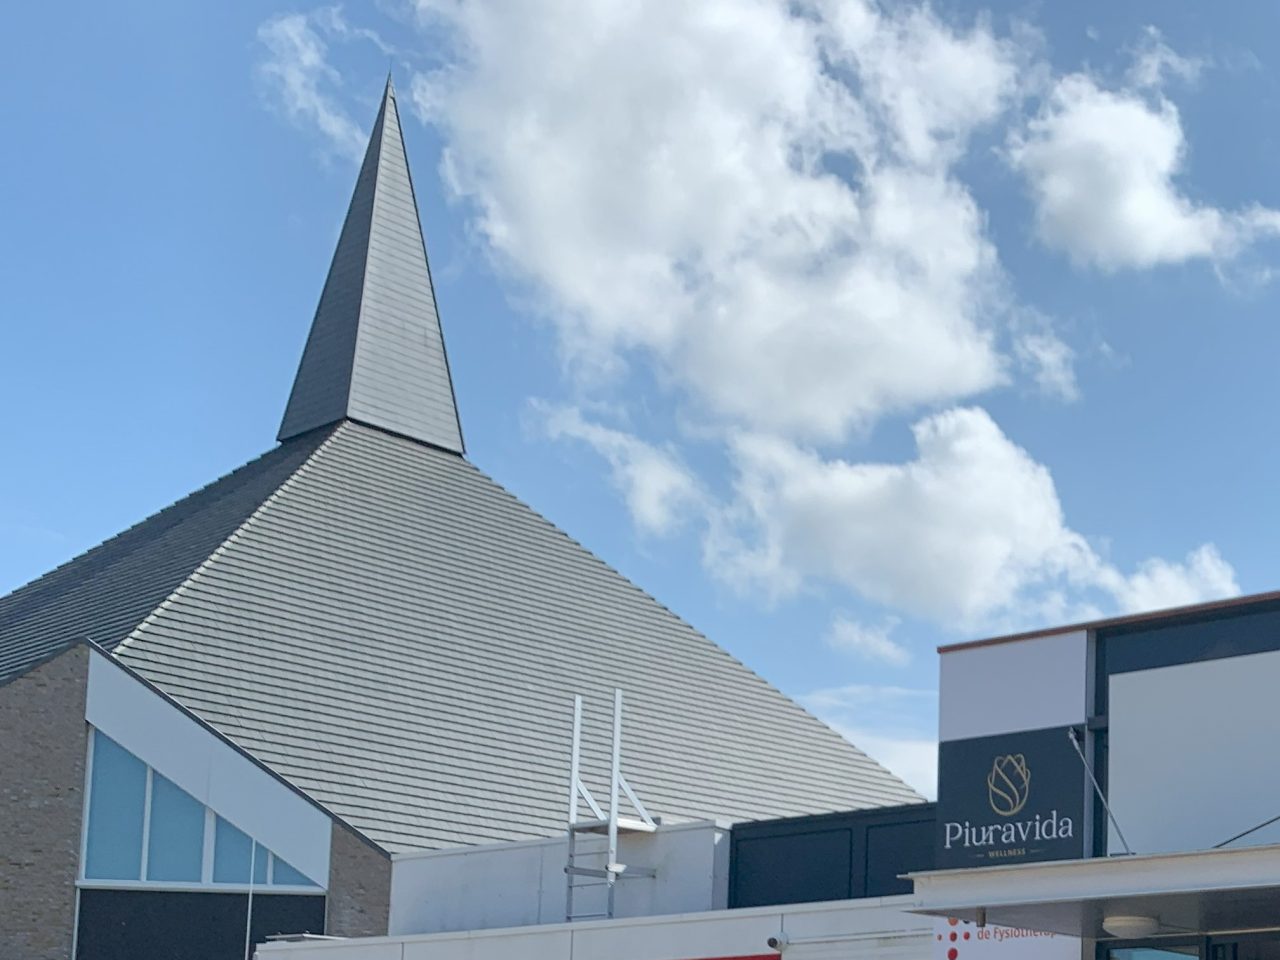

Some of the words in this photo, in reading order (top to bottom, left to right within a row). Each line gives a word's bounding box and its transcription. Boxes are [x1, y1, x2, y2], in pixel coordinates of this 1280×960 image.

[944, 810, 1073, 849] Piuravida
[988, 848, 1026, 858] WELLNESS
[977, 927, 990, 940] de
